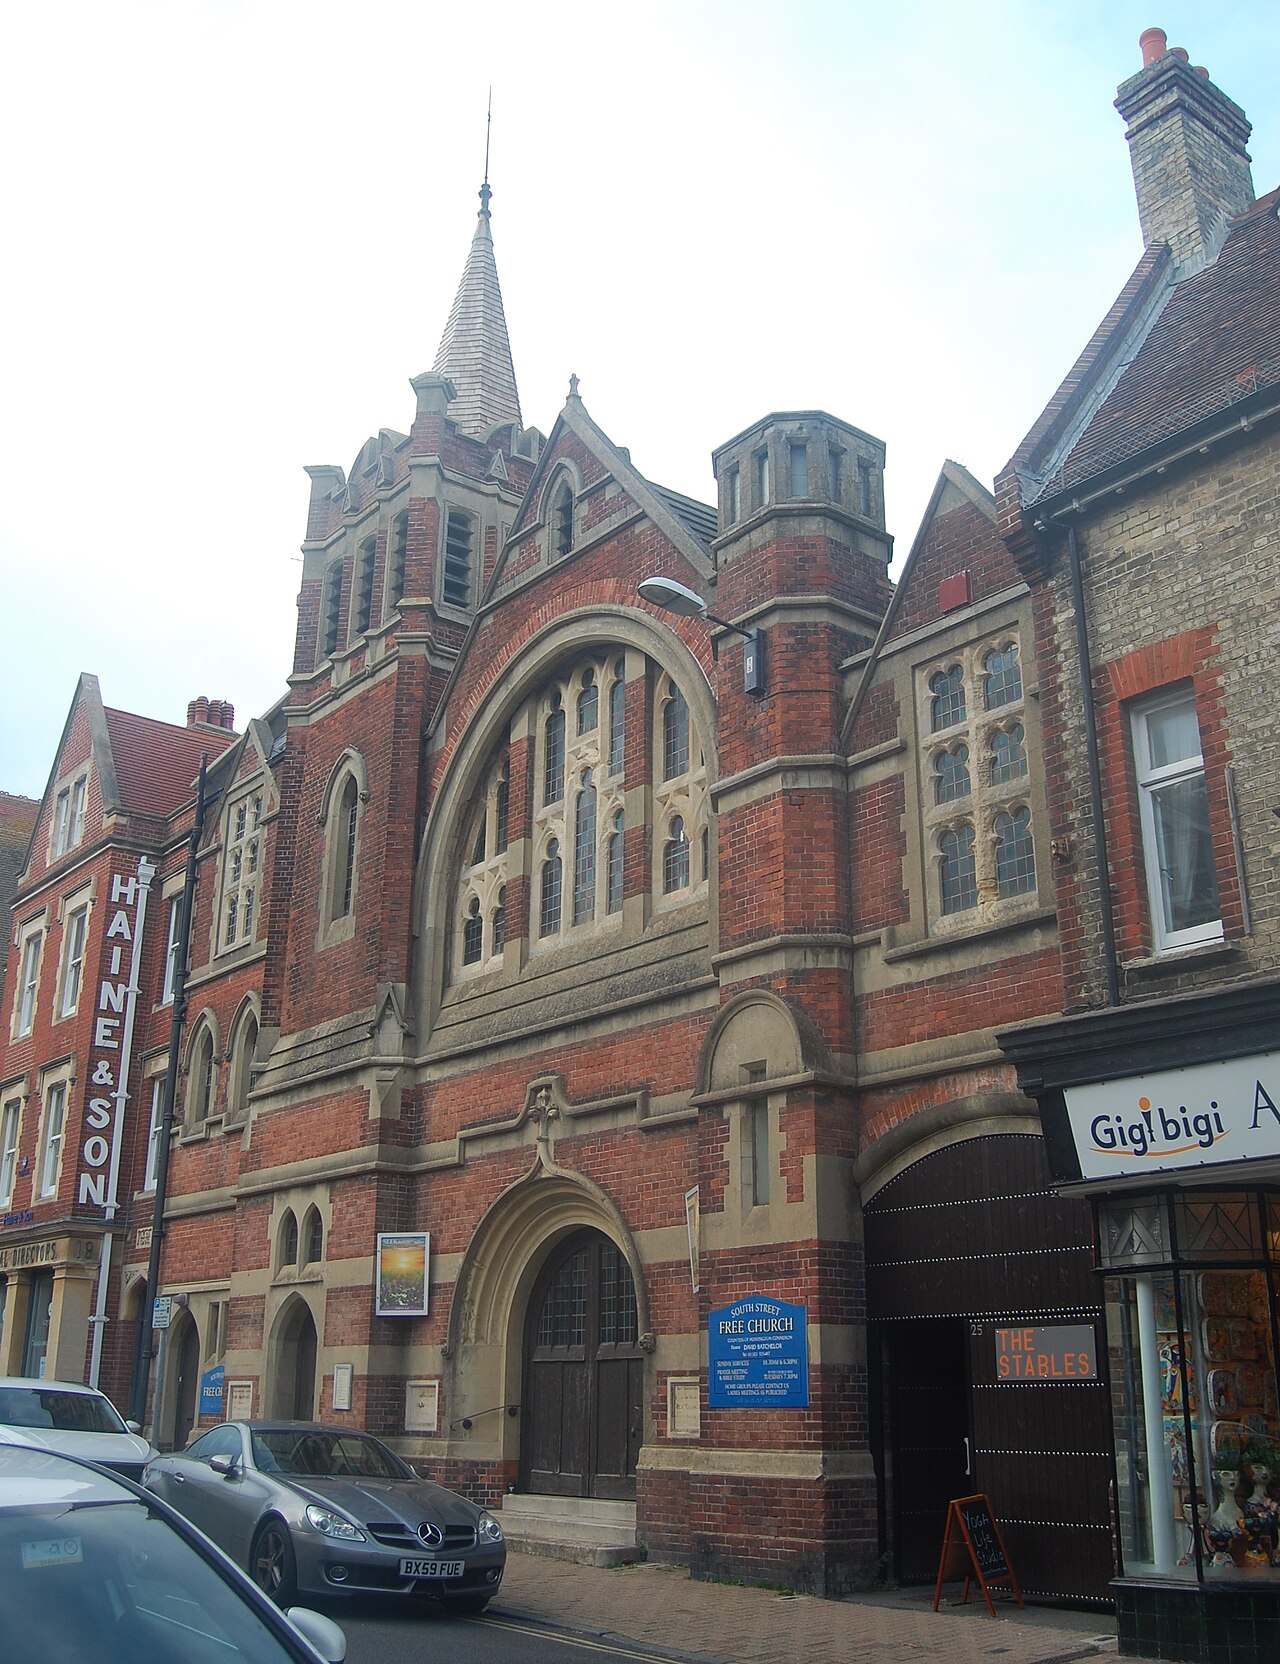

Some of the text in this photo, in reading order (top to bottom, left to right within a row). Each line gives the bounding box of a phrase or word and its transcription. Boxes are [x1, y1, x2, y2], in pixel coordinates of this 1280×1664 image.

[79, 874, 136, 1205] HAINE & SON
[730, 1303, 782, 1318] SOUTH STREET
[719, 1317, 793, 1334] FREE CHURCH
[970, 1324, 983, 1336] 25
[999, 1329, 1035, 1352] THE
[999, 1353, 1089, 1377] STABLES
[961, 1510, 989, 1530] YOGA
[973, 1530, 993, 1550] Life
[976, 1549, 1004, 1566] Studio
[404, 1561, 461, 1575] BX59 FUE
